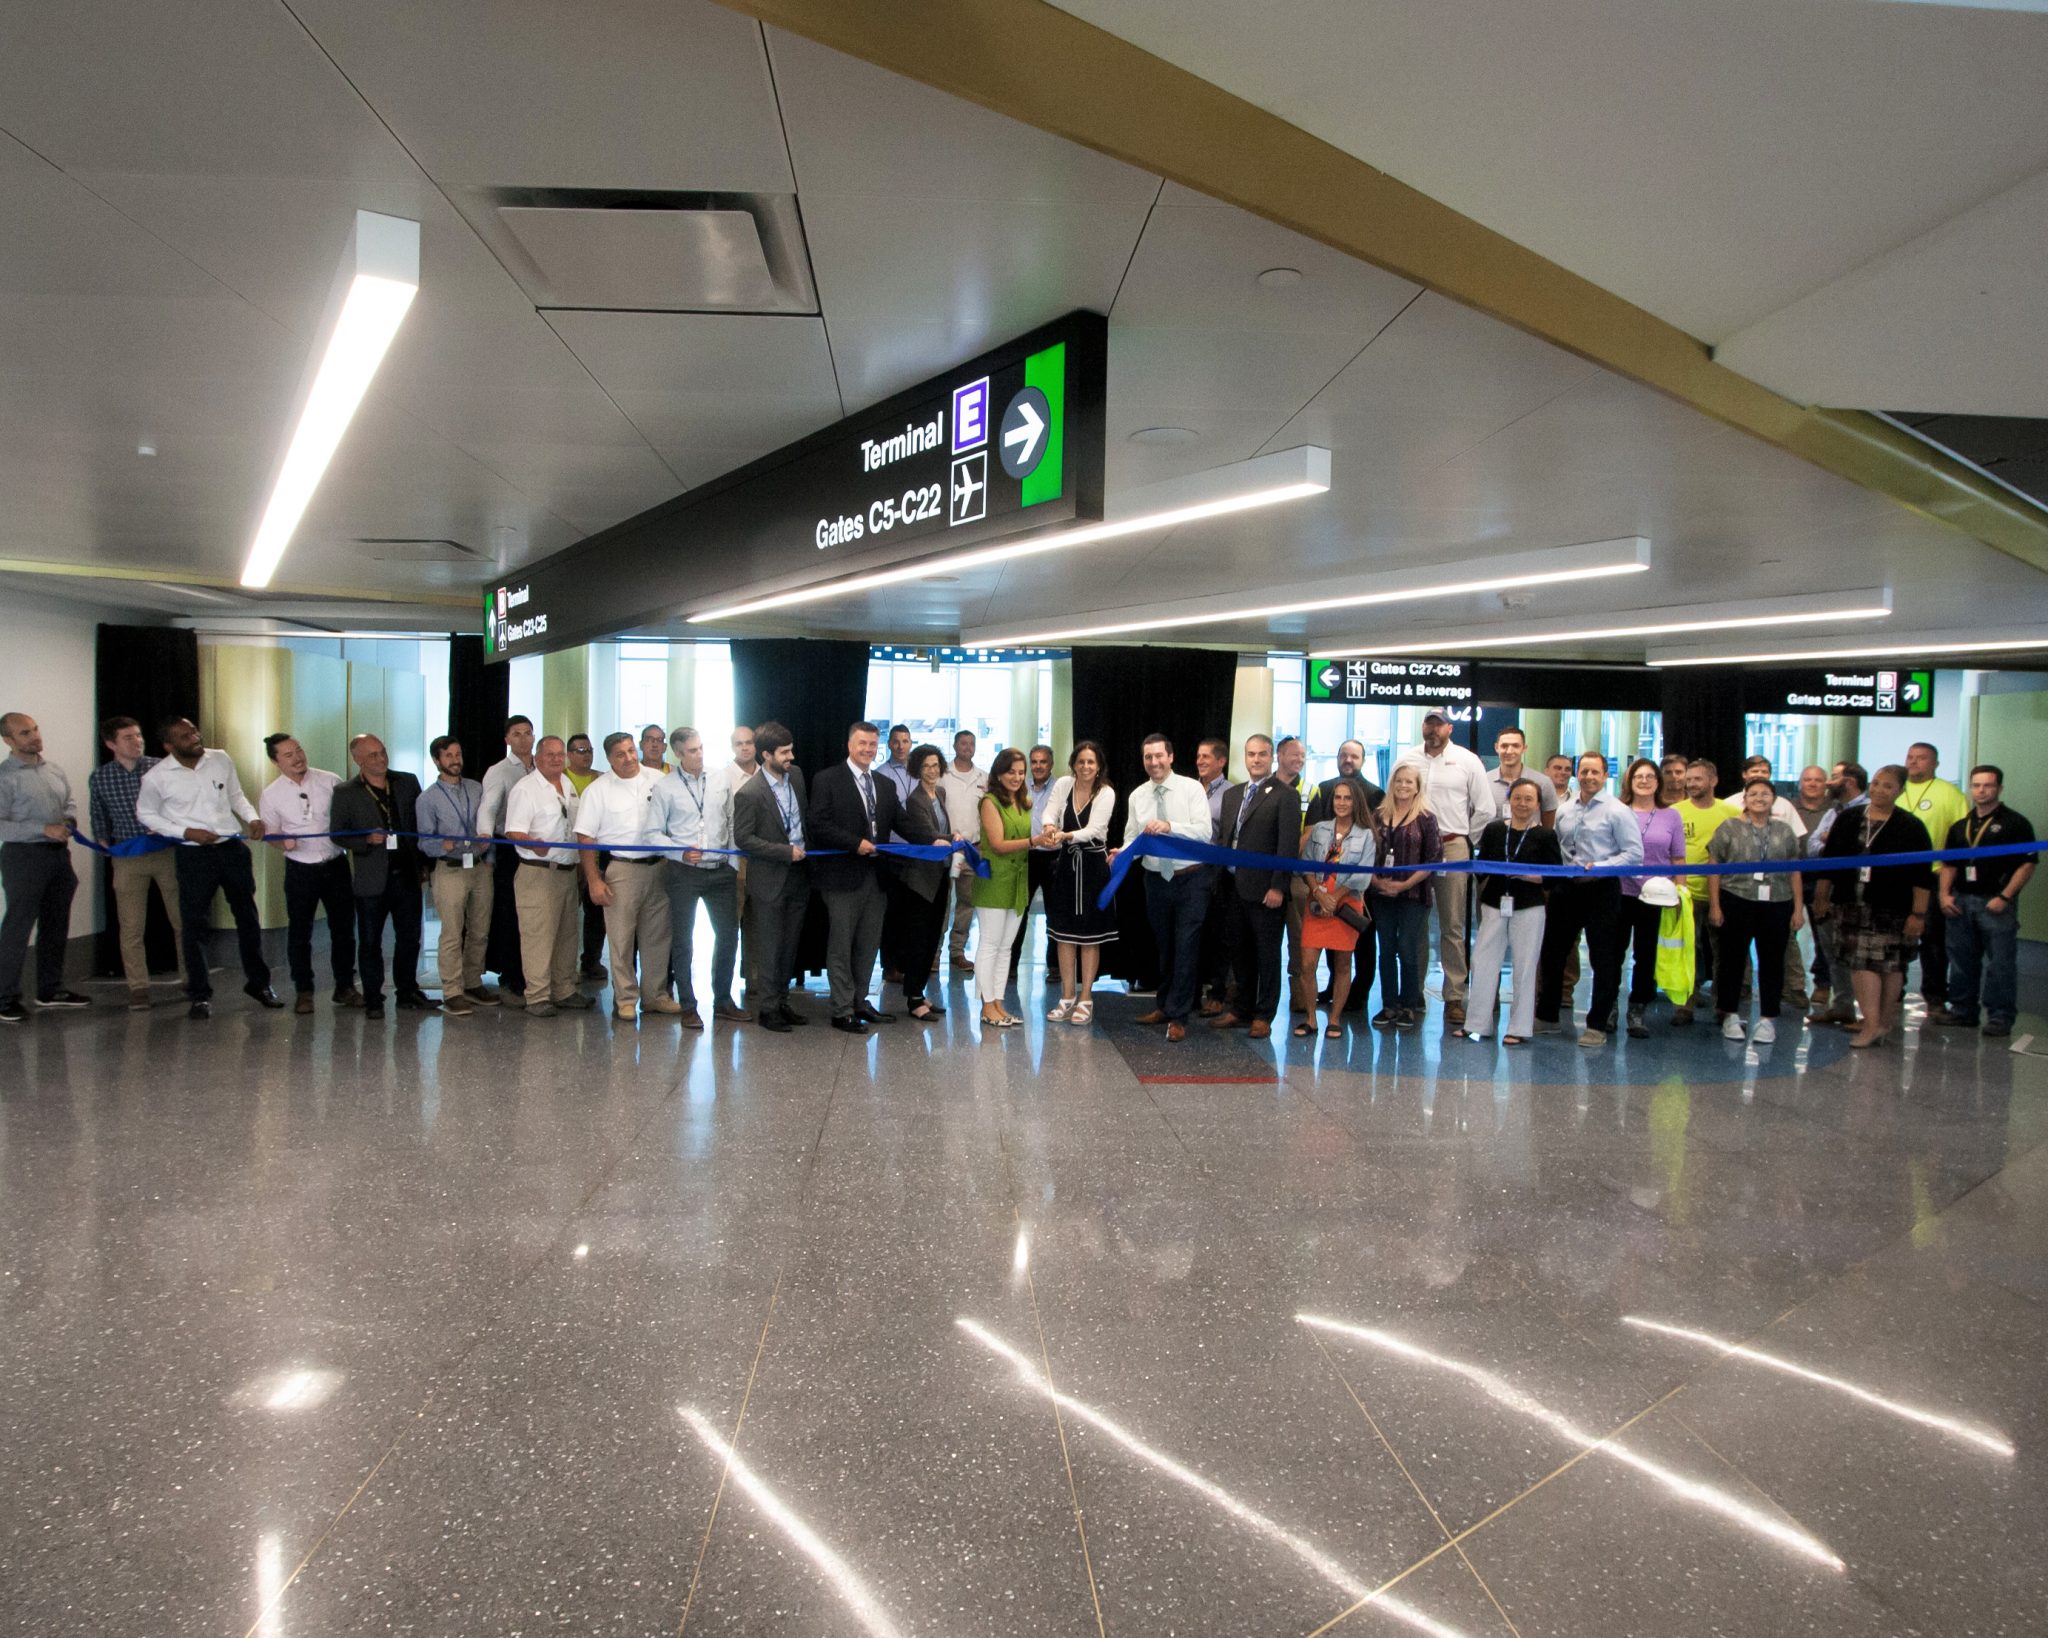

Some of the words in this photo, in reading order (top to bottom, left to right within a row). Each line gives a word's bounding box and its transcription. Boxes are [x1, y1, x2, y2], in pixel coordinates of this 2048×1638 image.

[861, 411, 943, 472] Terminal
[960, 389, 981, 443] E
[816, 514, 864, 549] Gates
[869, 483, 942, 534] C5-C22
[1371, 662, 1406, 675] Gates
[1409, 663, 1461, 677] C27-C36
[1825, 674, 1874, 687] Terminal
[1370, 683, 1400, 696] Food
[1403, 684, 1413, 696] &
[1416, 685, 1472, 699] Beverage
[1787, 693, 1821, 706] Gates
[1824, 694, 1873, 707] C23-C25
